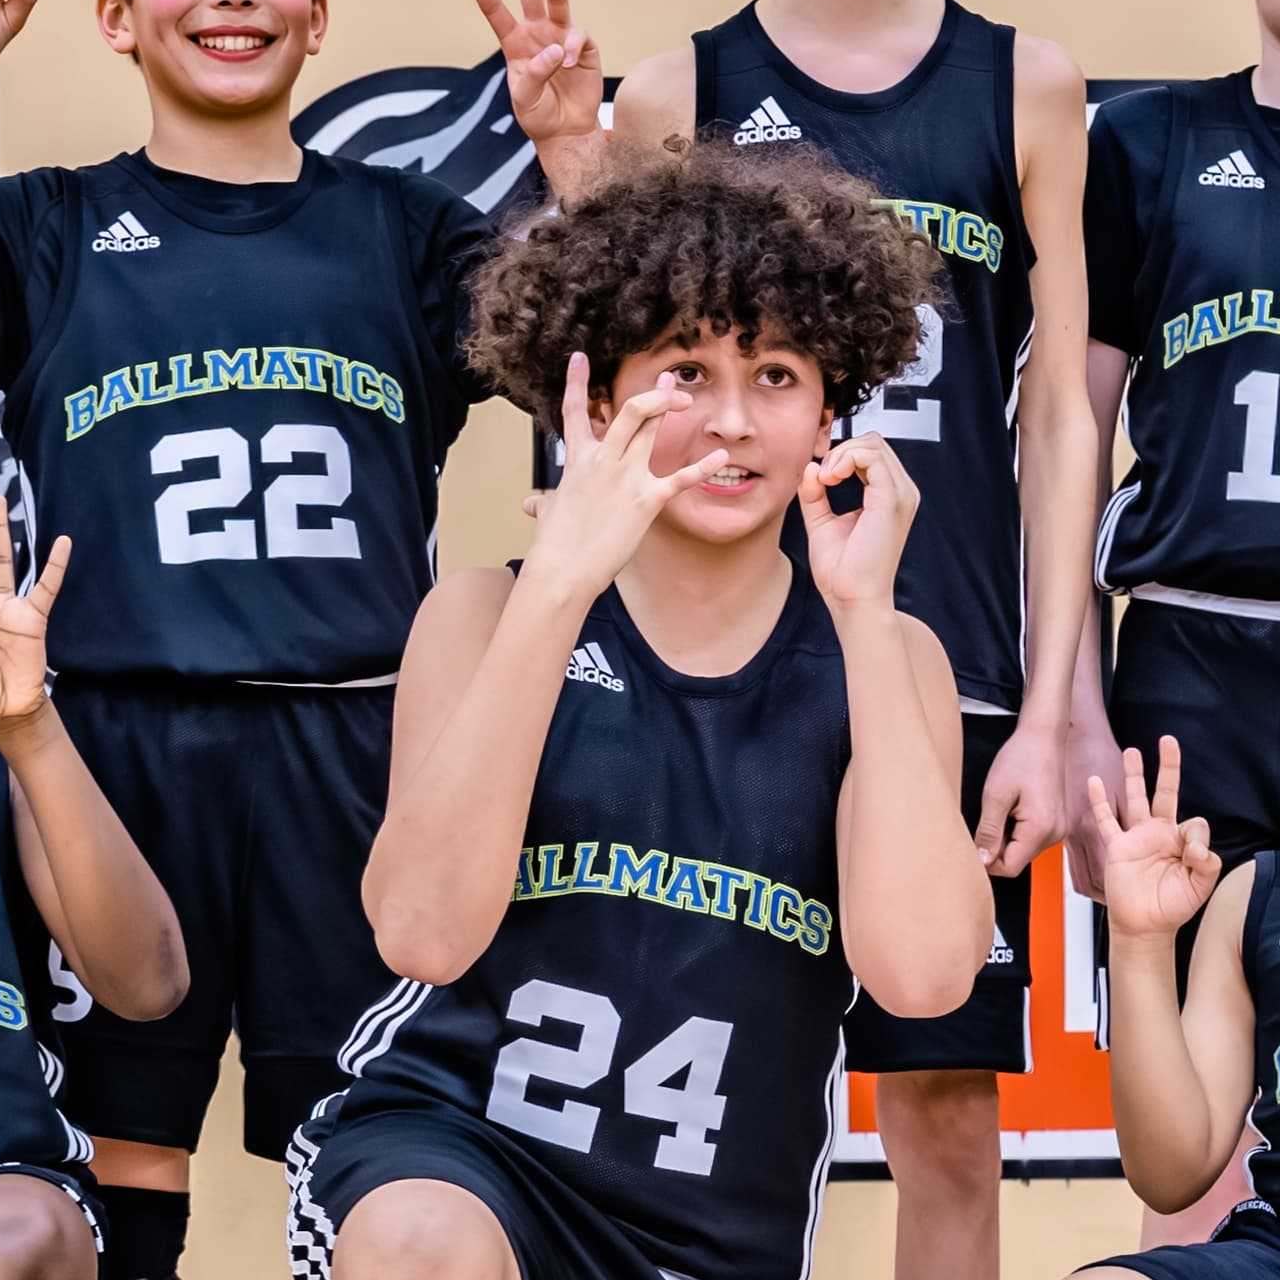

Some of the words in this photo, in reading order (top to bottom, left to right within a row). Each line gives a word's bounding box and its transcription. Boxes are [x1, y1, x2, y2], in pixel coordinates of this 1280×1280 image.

[734, 120, 801, 144] adidas
[1198, 169, 1265, 189] adidas
[92, 231, 161, 253] adidas
[64, 346, 406, 442] BALLMATICS
[830, 304, 943, 443] 2
[150, 424, 362, 565] 22
[565, 663, 625, 692] didas
[511, 841, 833, 956] ALLMATICS
[486, 978, 734, 1177] 24
